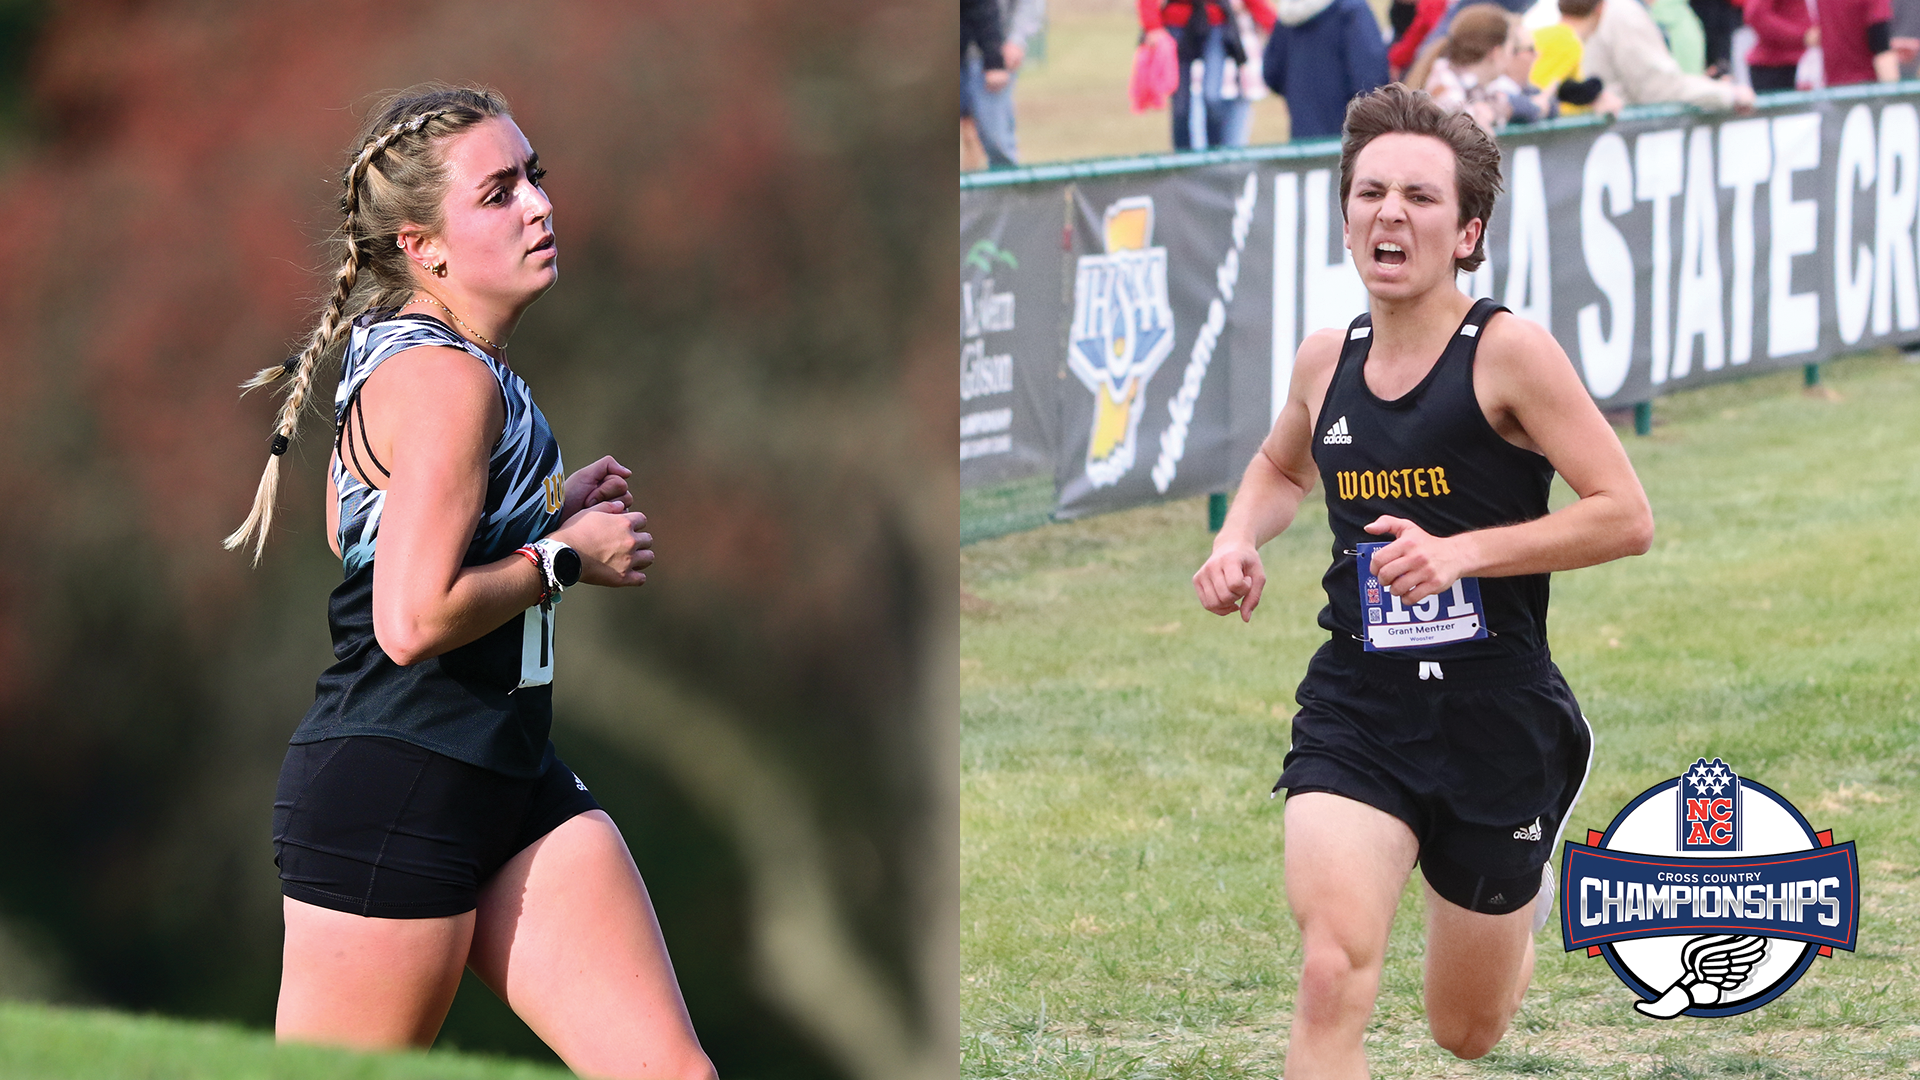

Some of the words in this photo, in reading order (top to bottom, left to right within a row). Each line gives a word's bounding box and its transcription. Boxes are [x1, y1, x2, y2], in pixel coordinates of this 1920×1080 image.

[1577, 111, 1823, 399] STATE
[1216, 247, 1240, 302] to
[1323, 433, 1353, 445] adidas
[1336, 466, 1452, 501] WOOSTER
[1383, 578, 1476, 623] 191
[1387, 626, 1413, 637] Grant
[1415, 622, 1456, 635] Mentzer
[1409, 635, 1435, 643] Wooster
